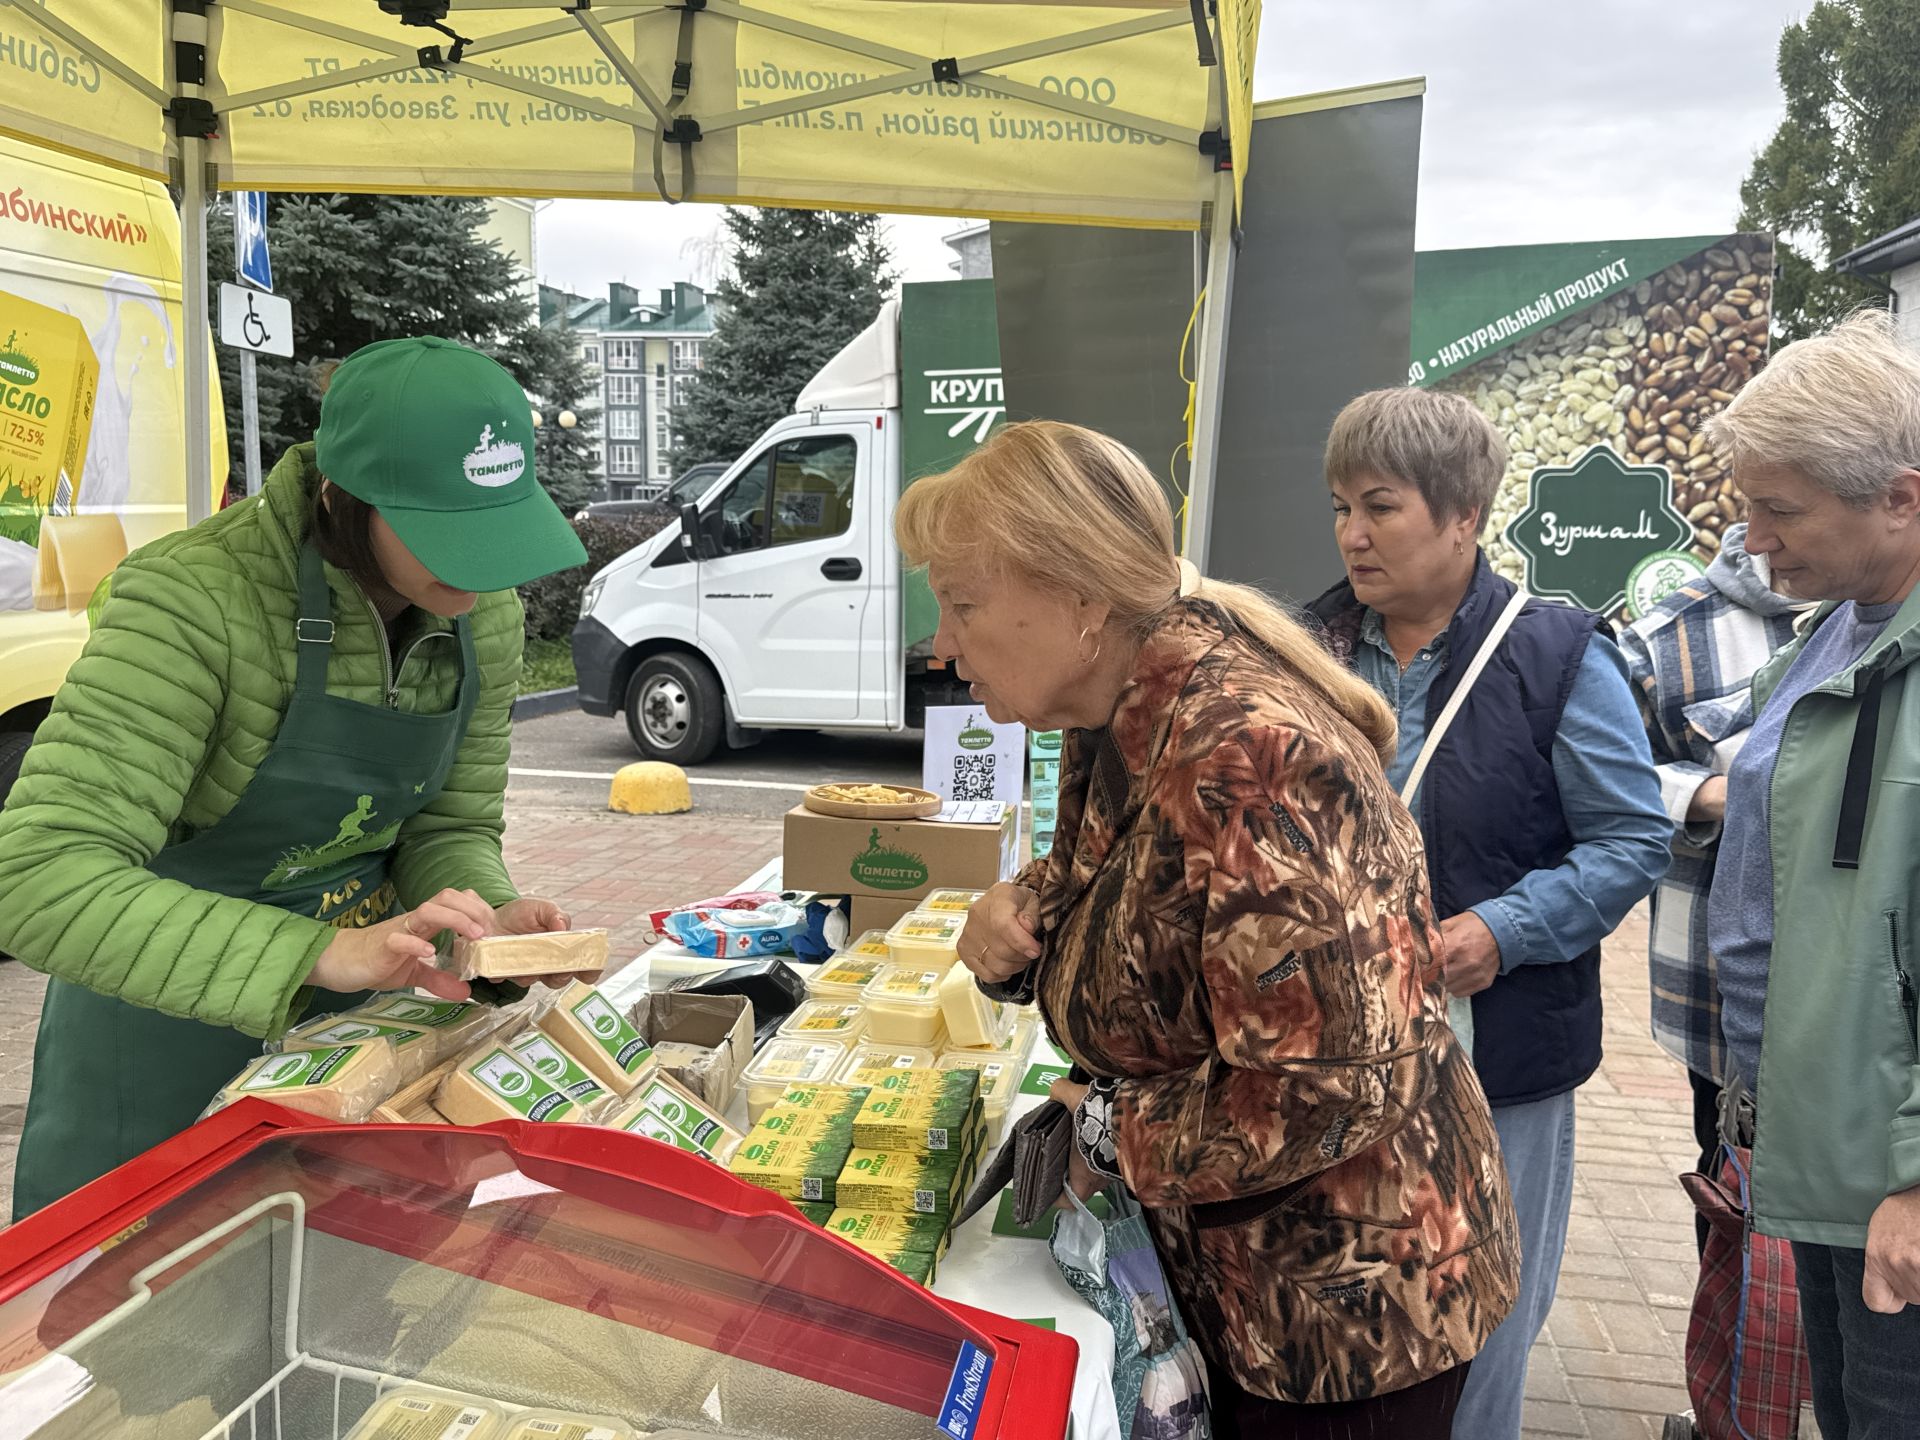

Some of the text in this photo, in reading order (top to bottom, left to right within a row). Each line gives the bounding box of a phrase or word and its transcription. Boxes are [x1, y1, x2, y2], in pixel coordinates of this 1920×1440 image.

[1438, 293, 1556, 369] НАТУРАЛЬНЫЙ
[1554, 257, 1632, 311] ПРОДУКТ
[0, 362, 36, 380] амлетто
[930, 377, 1006, 405] КРУП
[10, 422, 45, 448] 72,5%
[857, 863, 922, 879] Тамлетто
[760, 934, 780, 943] AURA
